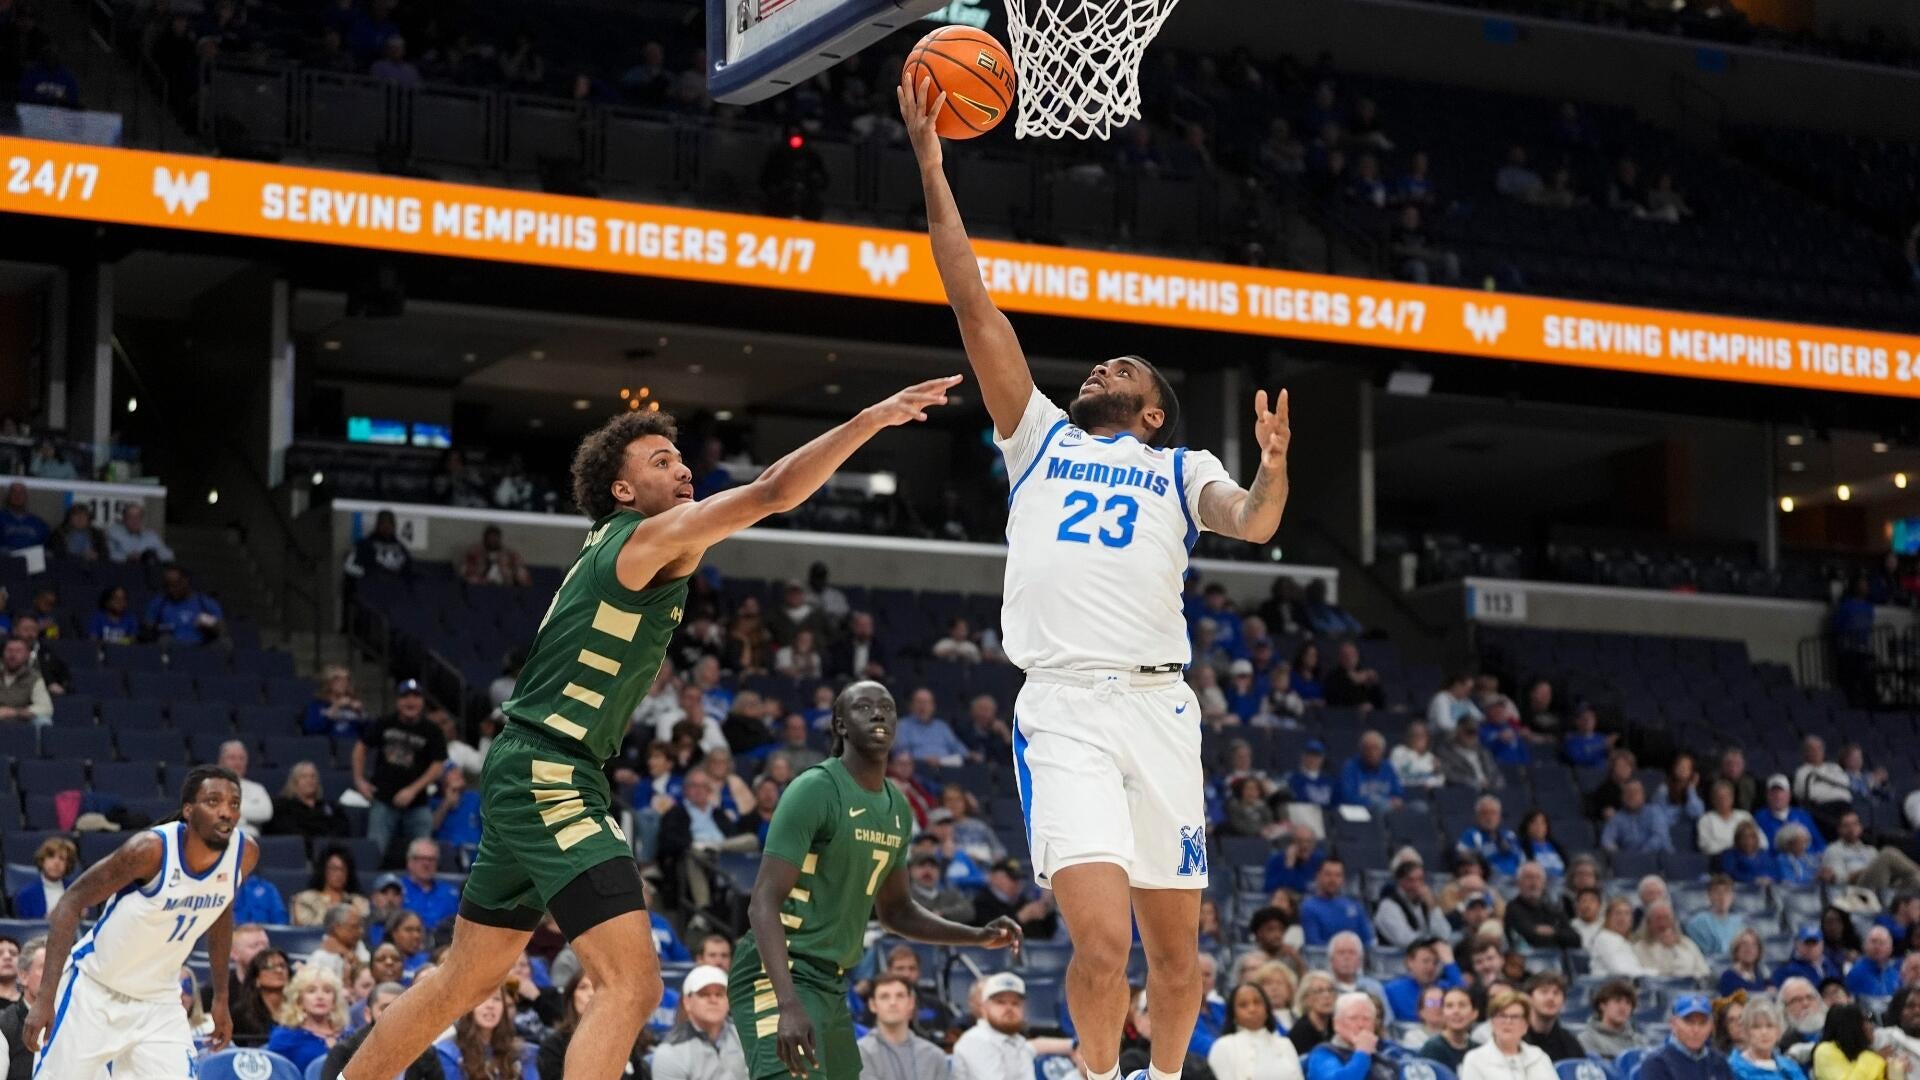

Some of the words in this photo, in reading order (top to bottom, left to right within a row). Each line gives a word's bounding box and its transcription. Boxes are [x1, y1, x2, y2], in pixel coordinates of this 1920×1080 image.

[7, 157, 99, 200] 24/7
[261, 184, 421, 234] SERVING
[432, 202, 598, 252] MEMPHIS
[605, 218, 728, 265] TIGERS
[735, 232, 816, 273] 24/7
[976, 256, 1090, 301] ERVING
[1096, 270, 1240, 316] MEMPHIS
[1245, 284, 1351, 327] TIGERS
[1357, 296, 1426, 333] 24/7
[1543, 315, 1663, 358] SERVING
[1669, 329, 1793, 370] MEMPHIS
[1798, 340, 1889, 379] TIGERS
[1044, 456, 1170, 497] Memphis
[1056, 489, 1140, 548] 23
[866, 849, 890, 896] 7
[167, 914, 198, 943] 11
